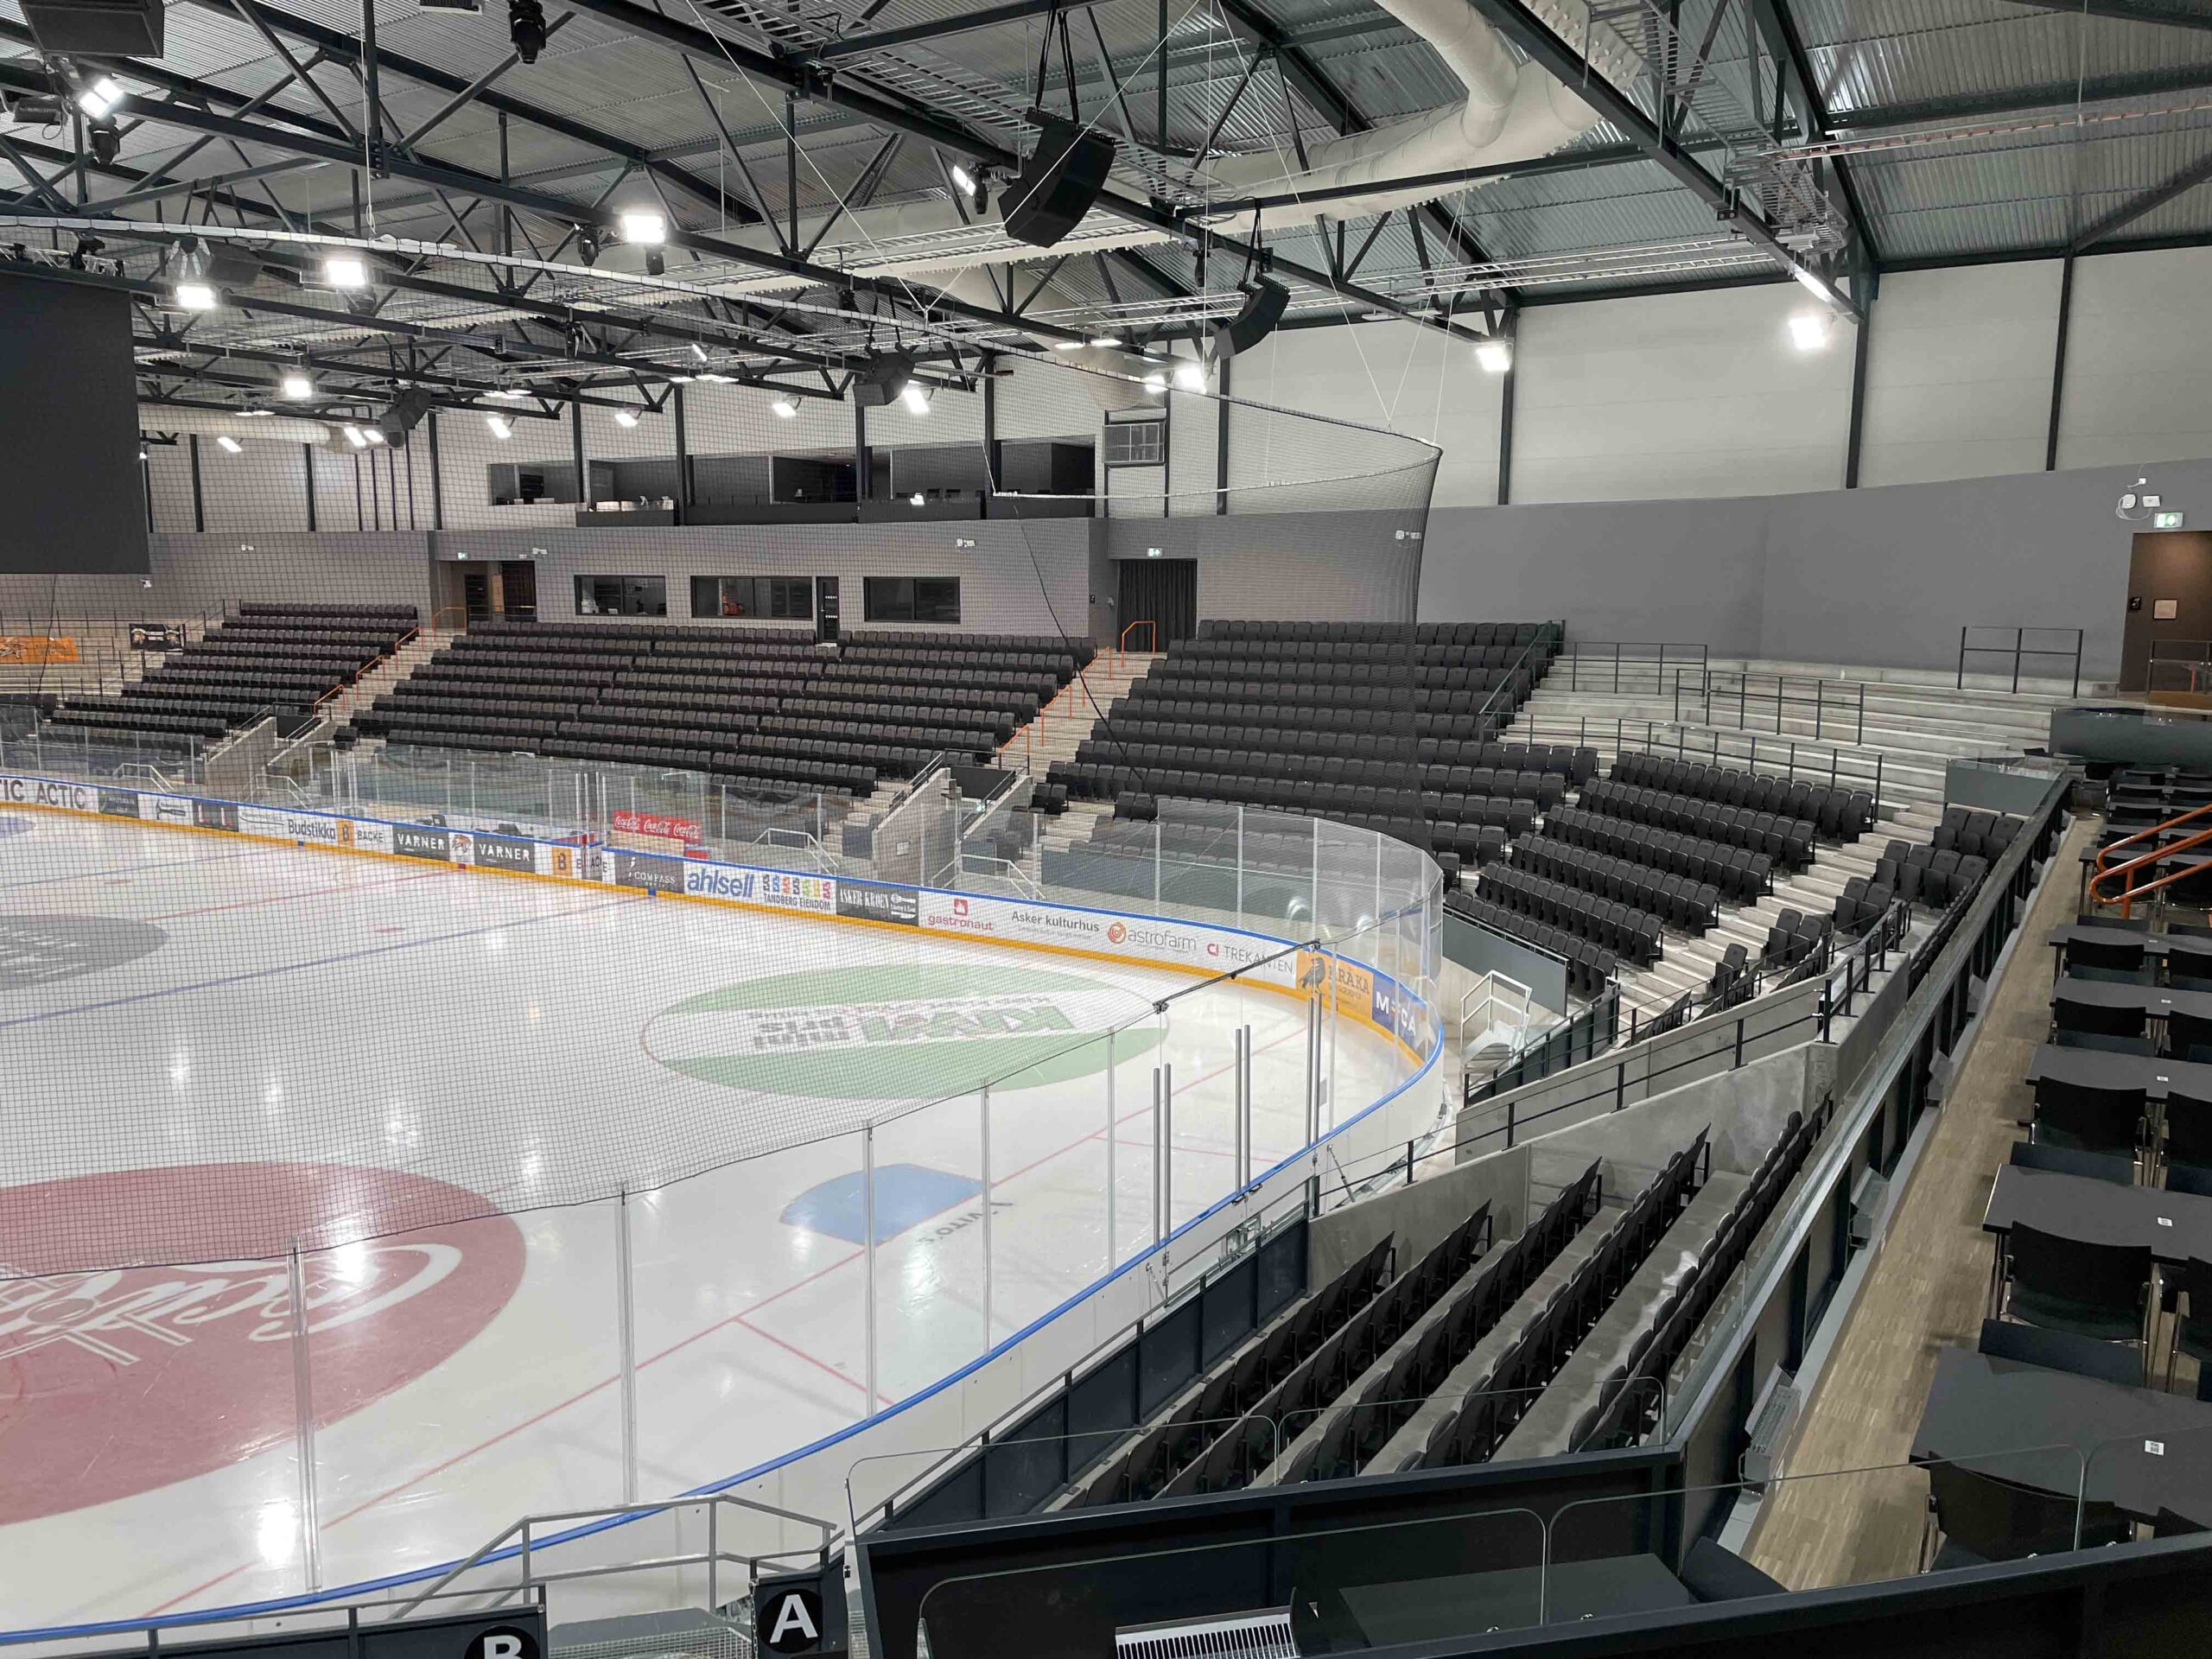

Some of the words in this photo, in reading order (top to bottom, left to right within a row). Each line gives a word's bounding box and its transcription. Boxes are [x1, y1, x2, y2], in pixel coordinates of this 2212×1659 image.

[35, 781, 86, 810] ACTIC
[288, 819, 336, 840] Budstikka
[357, 830, 385, 843] BACKE
[397, 833, 445, 851] VARNER
[479, 842, 531, 862] VARNER
[634, 871, 676, 885] COMPASS
[687, 868, 755, 899] ahlsell
[764, 893, 798, 906] TANDBERG
[799, 899, 831, 911] EIENDOM
[927, 914, 995, 931] gastronaut
[1011, 911, 1043, 924] Asker
[1046, 914, 1099, 932] kulturhus
[1128, 928, 1197, 951] astrofarm
[757, 1016, 846, 1033] pris
[770, 1594, 818, 1643] A
